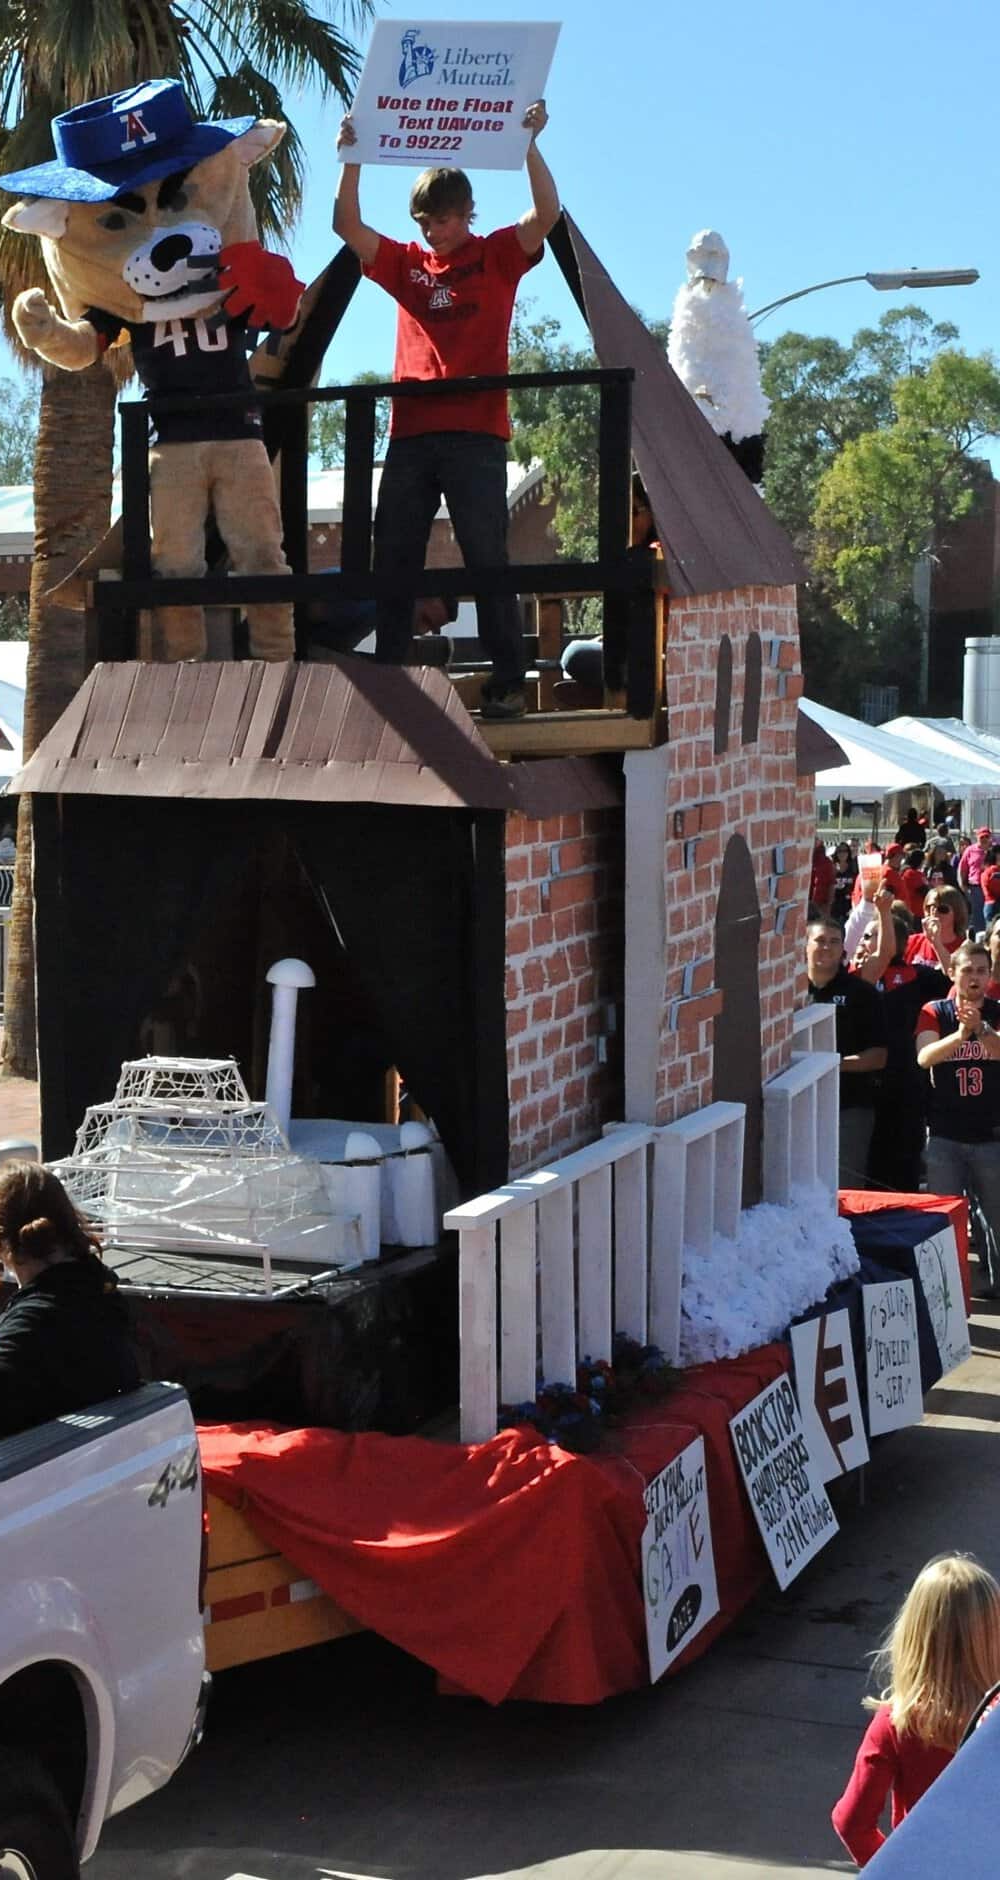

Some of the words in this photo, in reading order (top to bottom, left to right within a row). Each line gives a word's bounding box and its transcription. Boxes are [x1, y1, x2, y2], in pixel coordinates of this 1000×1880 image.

[443, 48, 514, 67] Liberty
[377, 95, 421, 112] Vote
[425, 97, 458, 112] the
[463, 98, 514, 113] Float
[119, 109, 157, 152] A
[399, 115, 433, 130] Text
[437, 116, 504, 131] UAVote
[379, 134, 400, 148] To
[405, 135, 463, 150] 99222
[153, 316, 228, 357] 40
[955, 1066, 983, 1097] 13
[734, 1380, 796, 1476] BOOKSTOP
